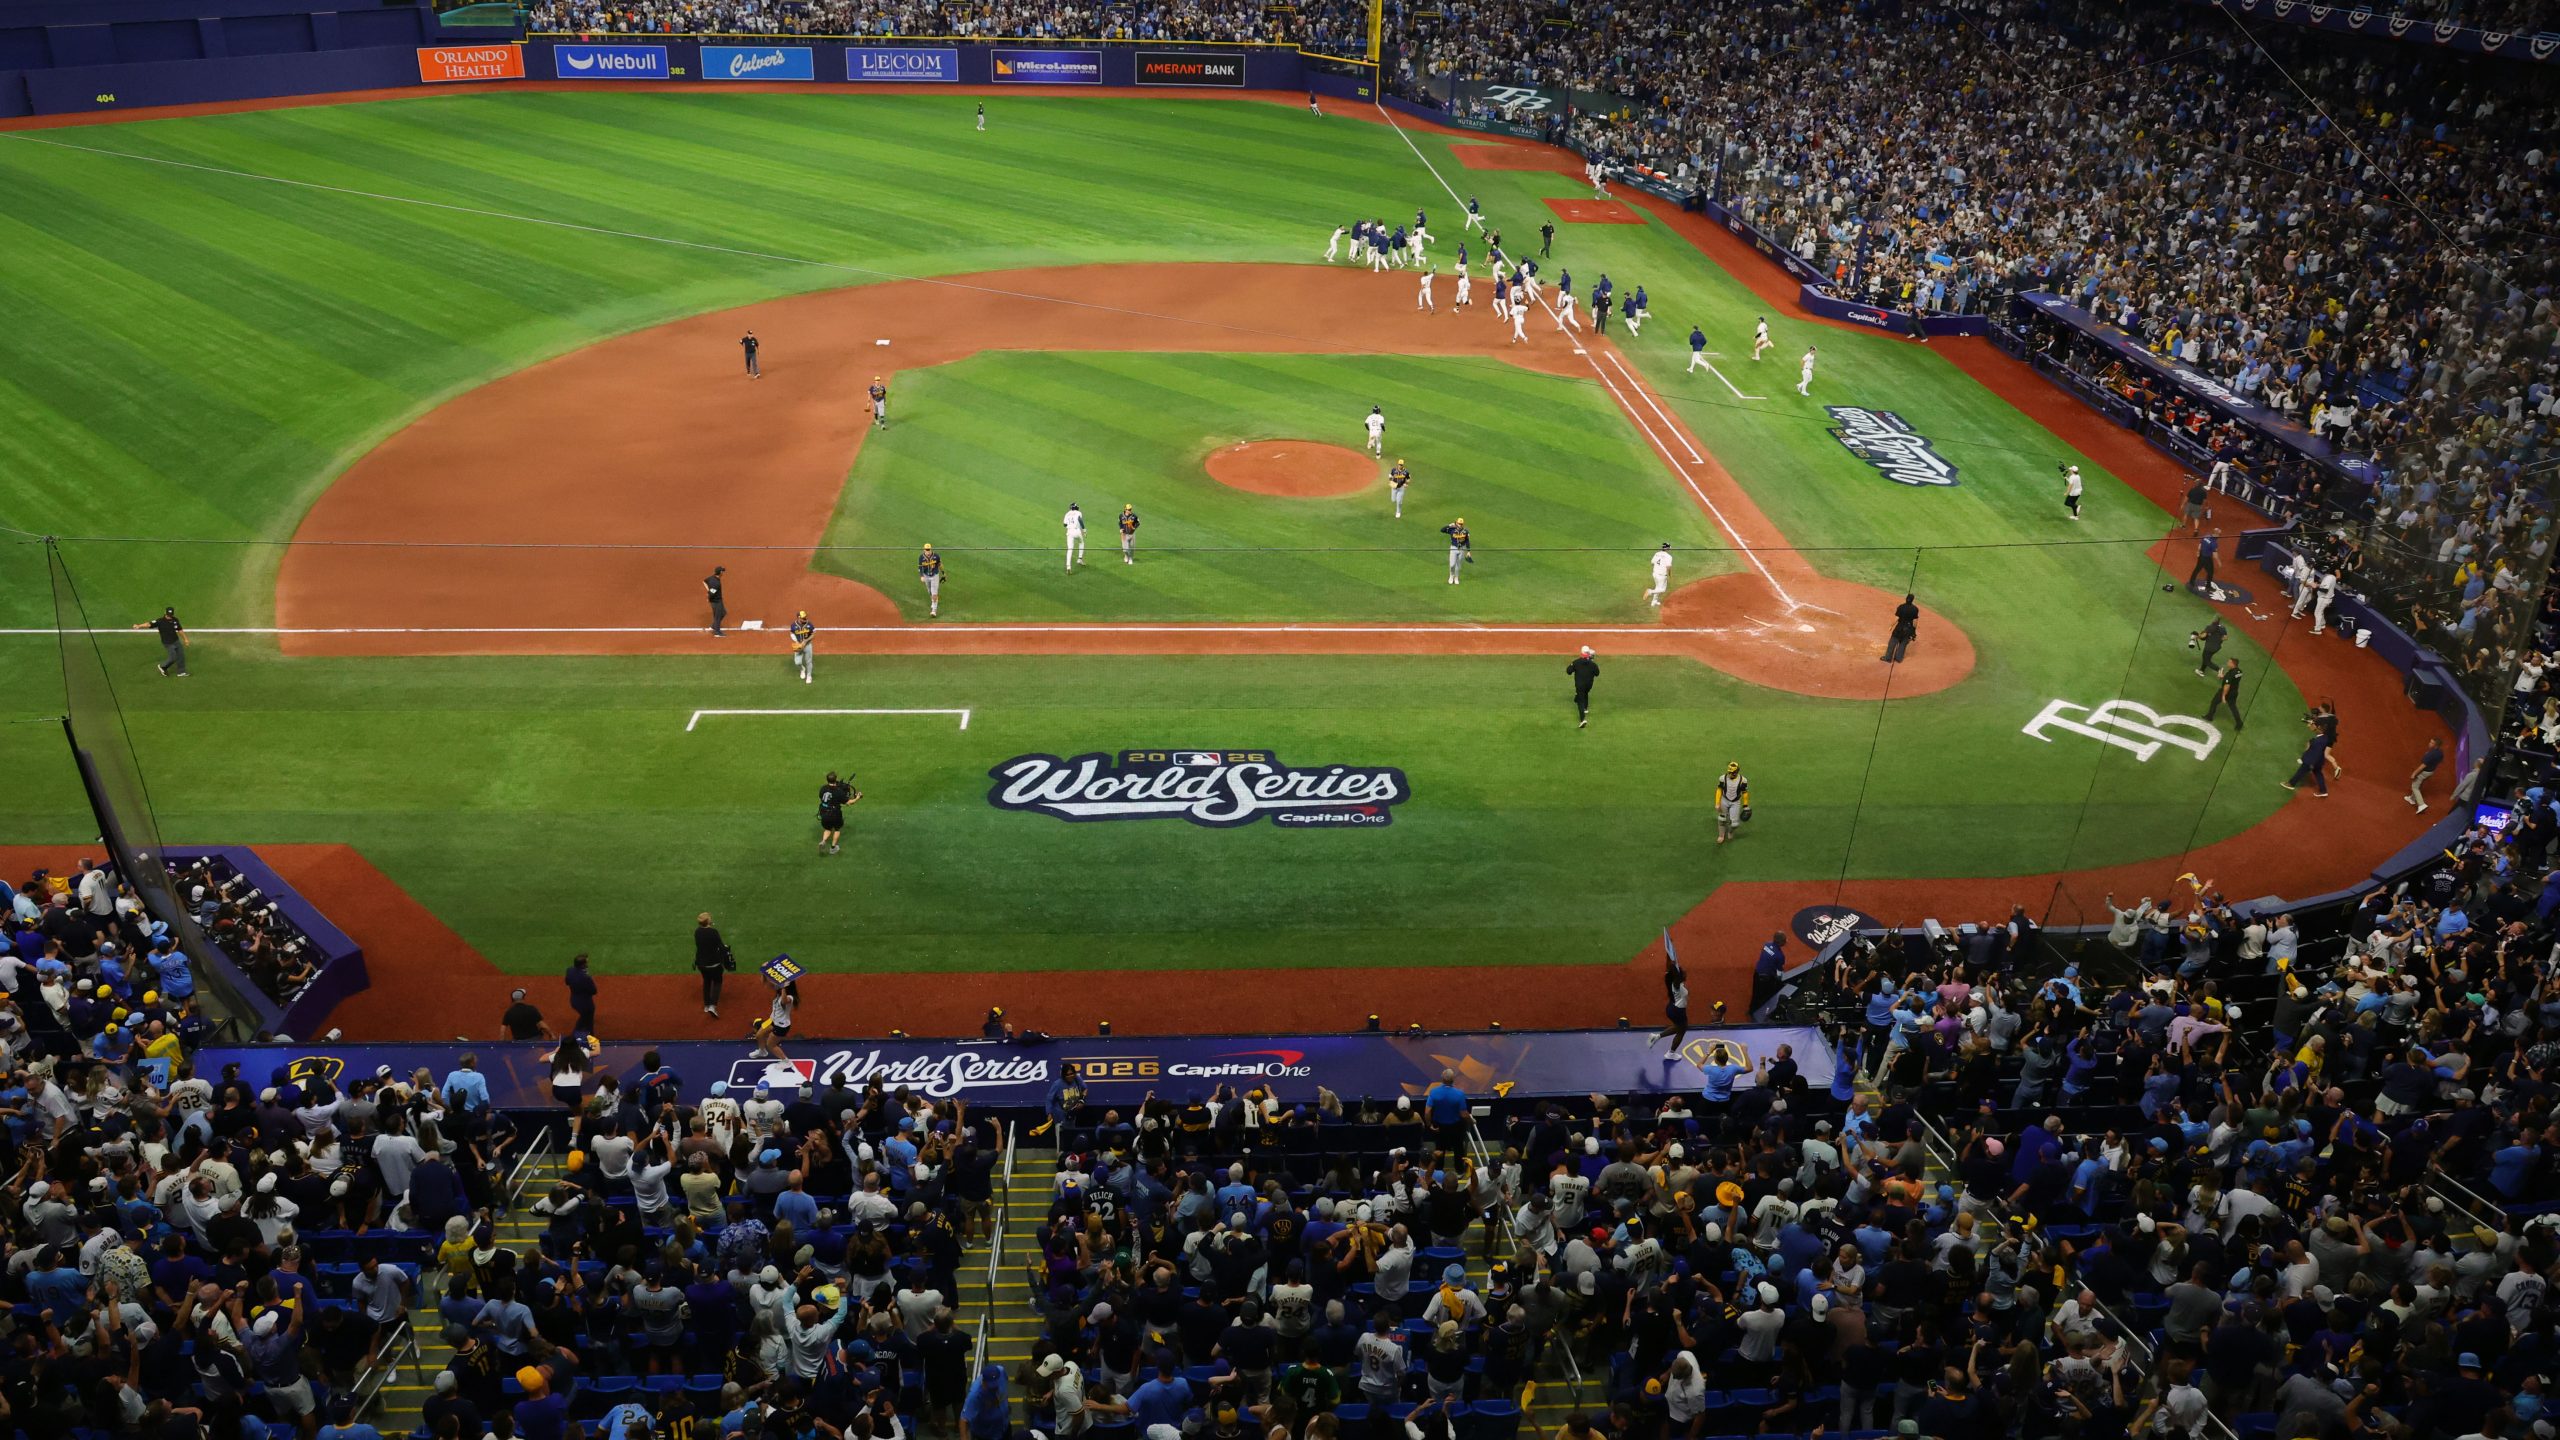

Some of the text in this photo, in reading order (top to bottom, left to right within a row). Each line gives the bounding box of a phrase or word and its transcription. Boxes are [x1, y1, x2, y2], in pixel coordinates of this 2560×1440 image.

[434, 51, 508, 64] ORLANDO
[597, 53, 656, 70] Webull
[730, 50, 785, 77] Culver's
[445, 65, 502, 77] HEALTH
[1017, 61, 1098, 71] MicroLumen
[1146, 63, 1235, 76] AMERANT BANK
[96, 94, 115, 102] 404
[1002, 758, 1399, 822] World Series
[773, 963, 794, 979] SOME
[781, 958, 801, 974] MAKE
[765, 967, 786, 983] NOISE
[149, 1075, 164, 1084] UD
[925, 1052, 1048, 1097] Series
[180, 1095, 202, 1110] 32
[707, 1111, 726, 1127] 24
[1089, 1191, 1114, 1201] YELICH
[1226, 1195, 1248, 1208] 44
[1564, 1191, 1575, 1204] 2
[2287, 1193, 2301, 1210] 11
[1090, 1201, 1115, 1221] 22
[1820, 1228, 1841, 1242] BRAUN
[1302, 1387, 1316, 1408] 4
